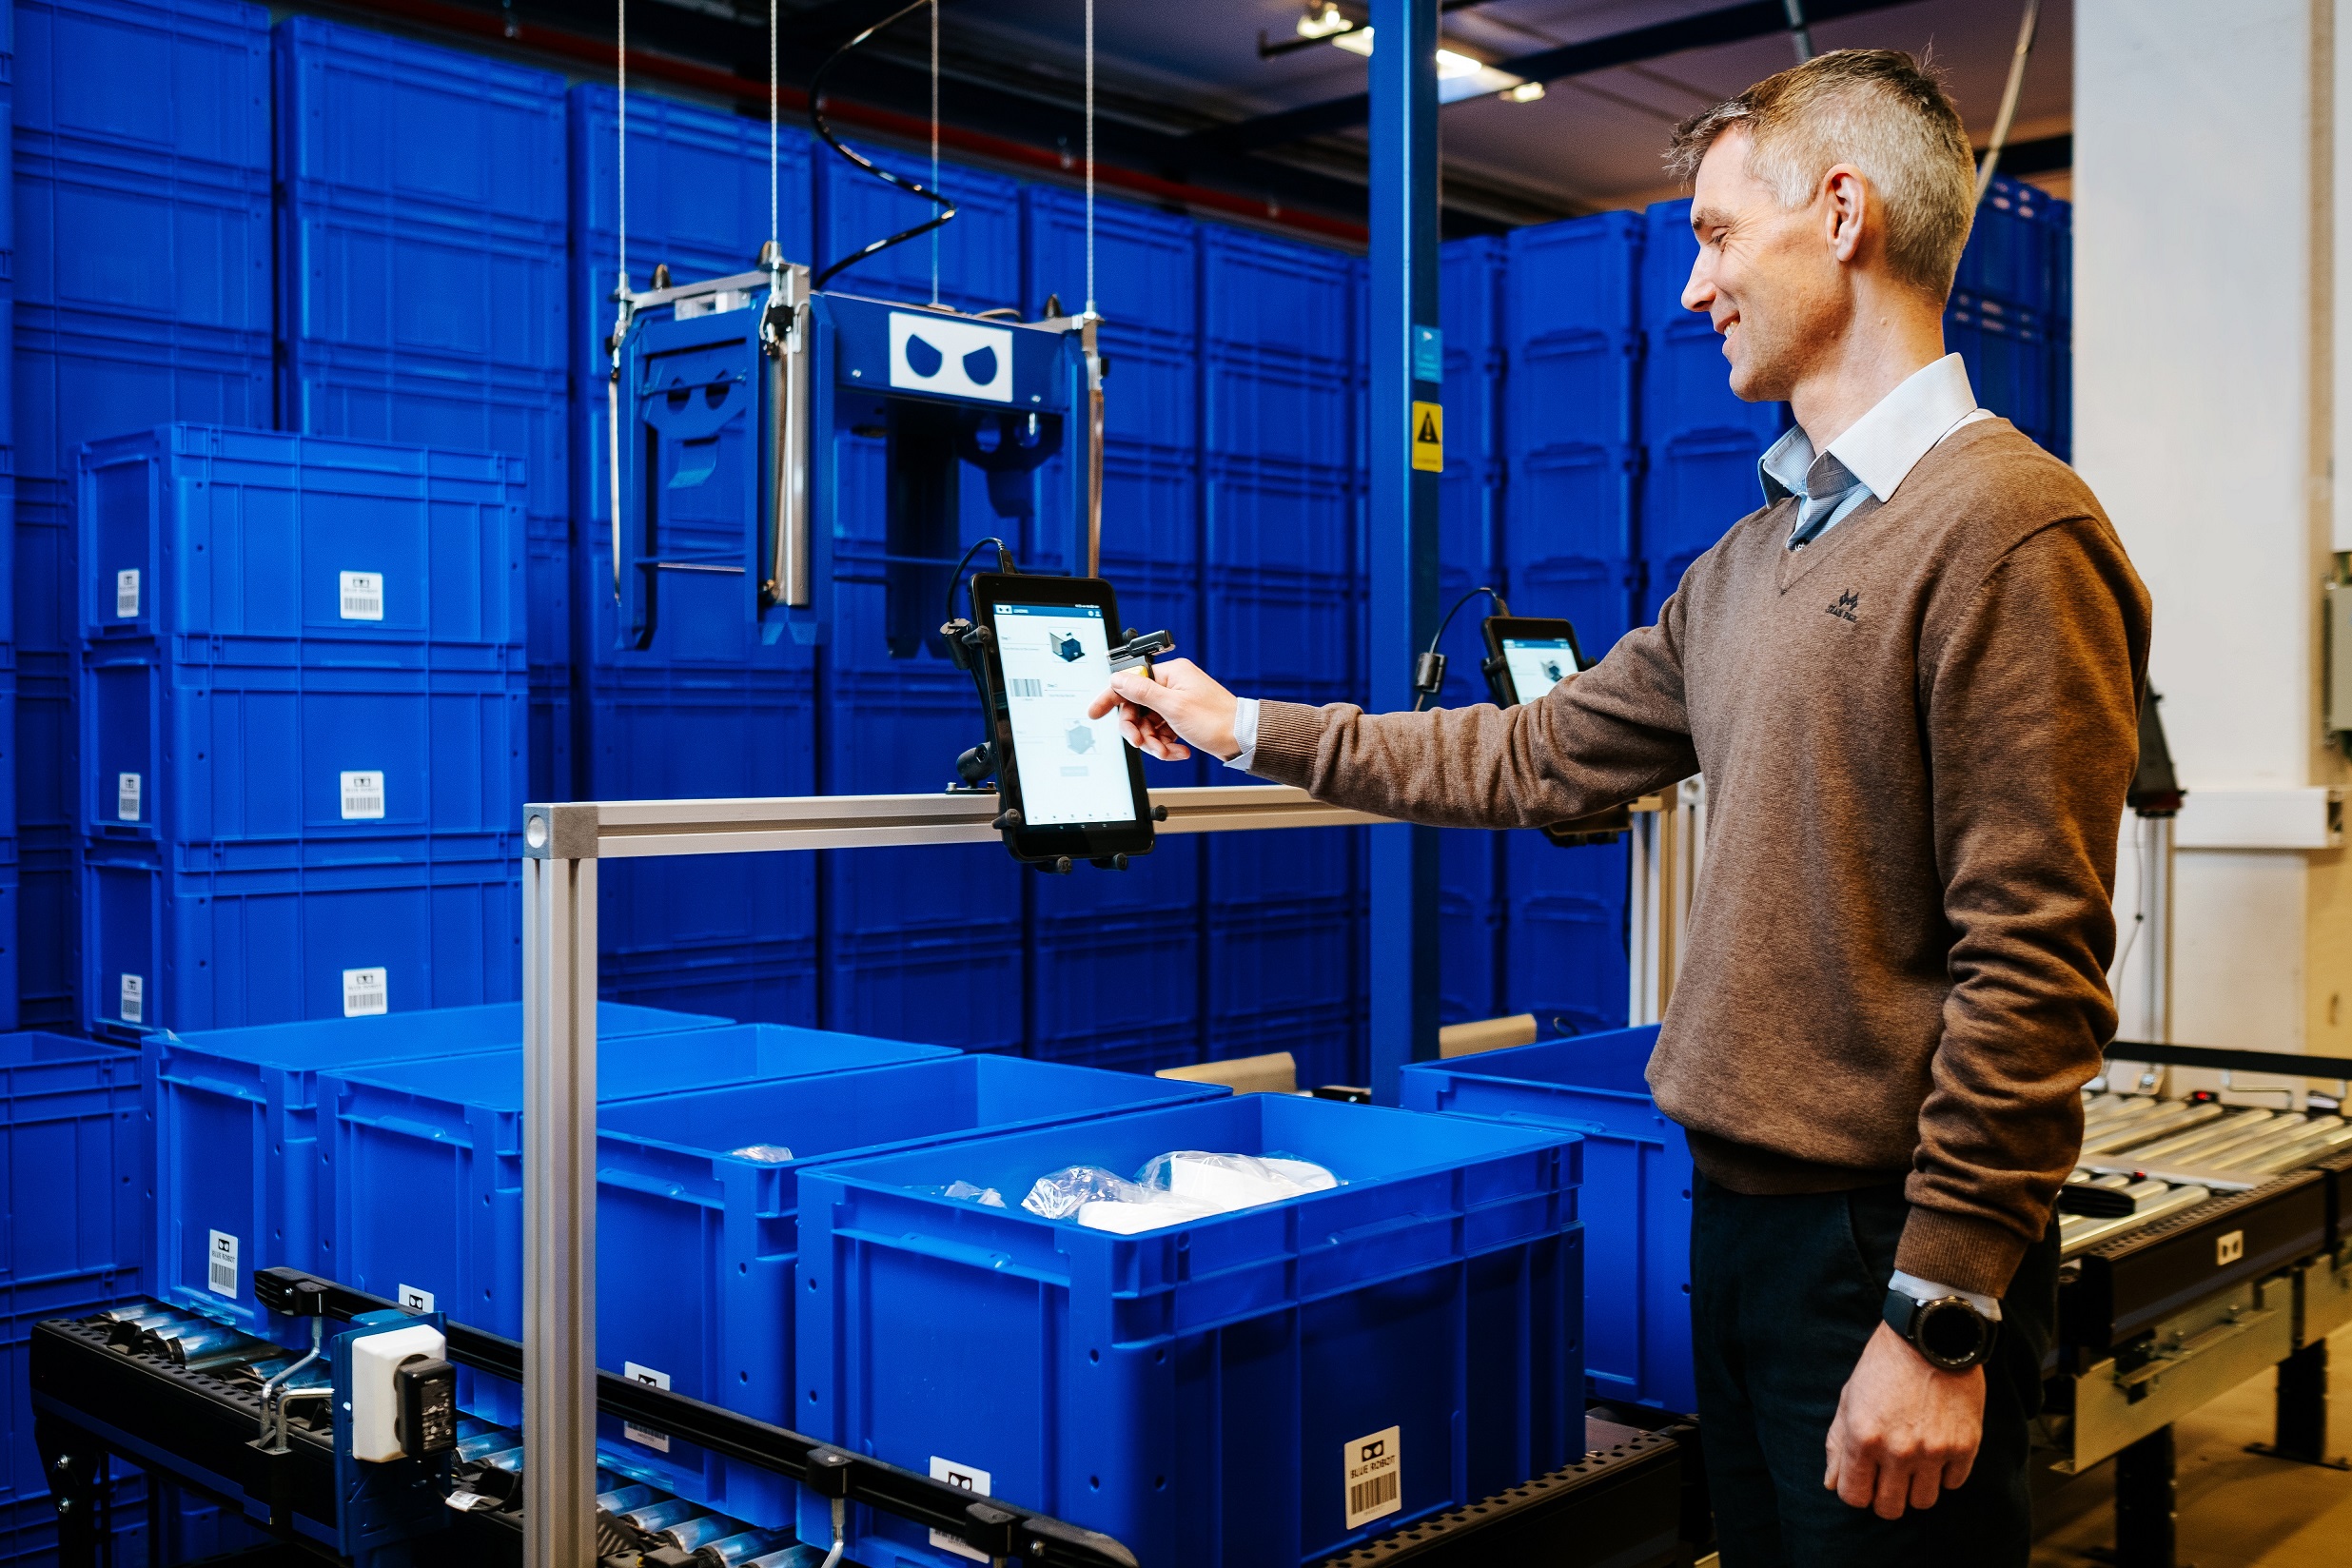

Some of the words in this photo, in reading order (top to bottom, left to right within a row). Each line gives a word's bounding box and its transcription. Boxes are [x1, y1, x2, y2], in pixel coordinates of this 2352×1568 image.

[211, 1250, 222, 1259] BLUE
[222, 1253, 236, 1264] ROBOT
[1350, 1465, 1368, 1480] BLUE
[1371, 1455, 1396, 1470] ROBOT
